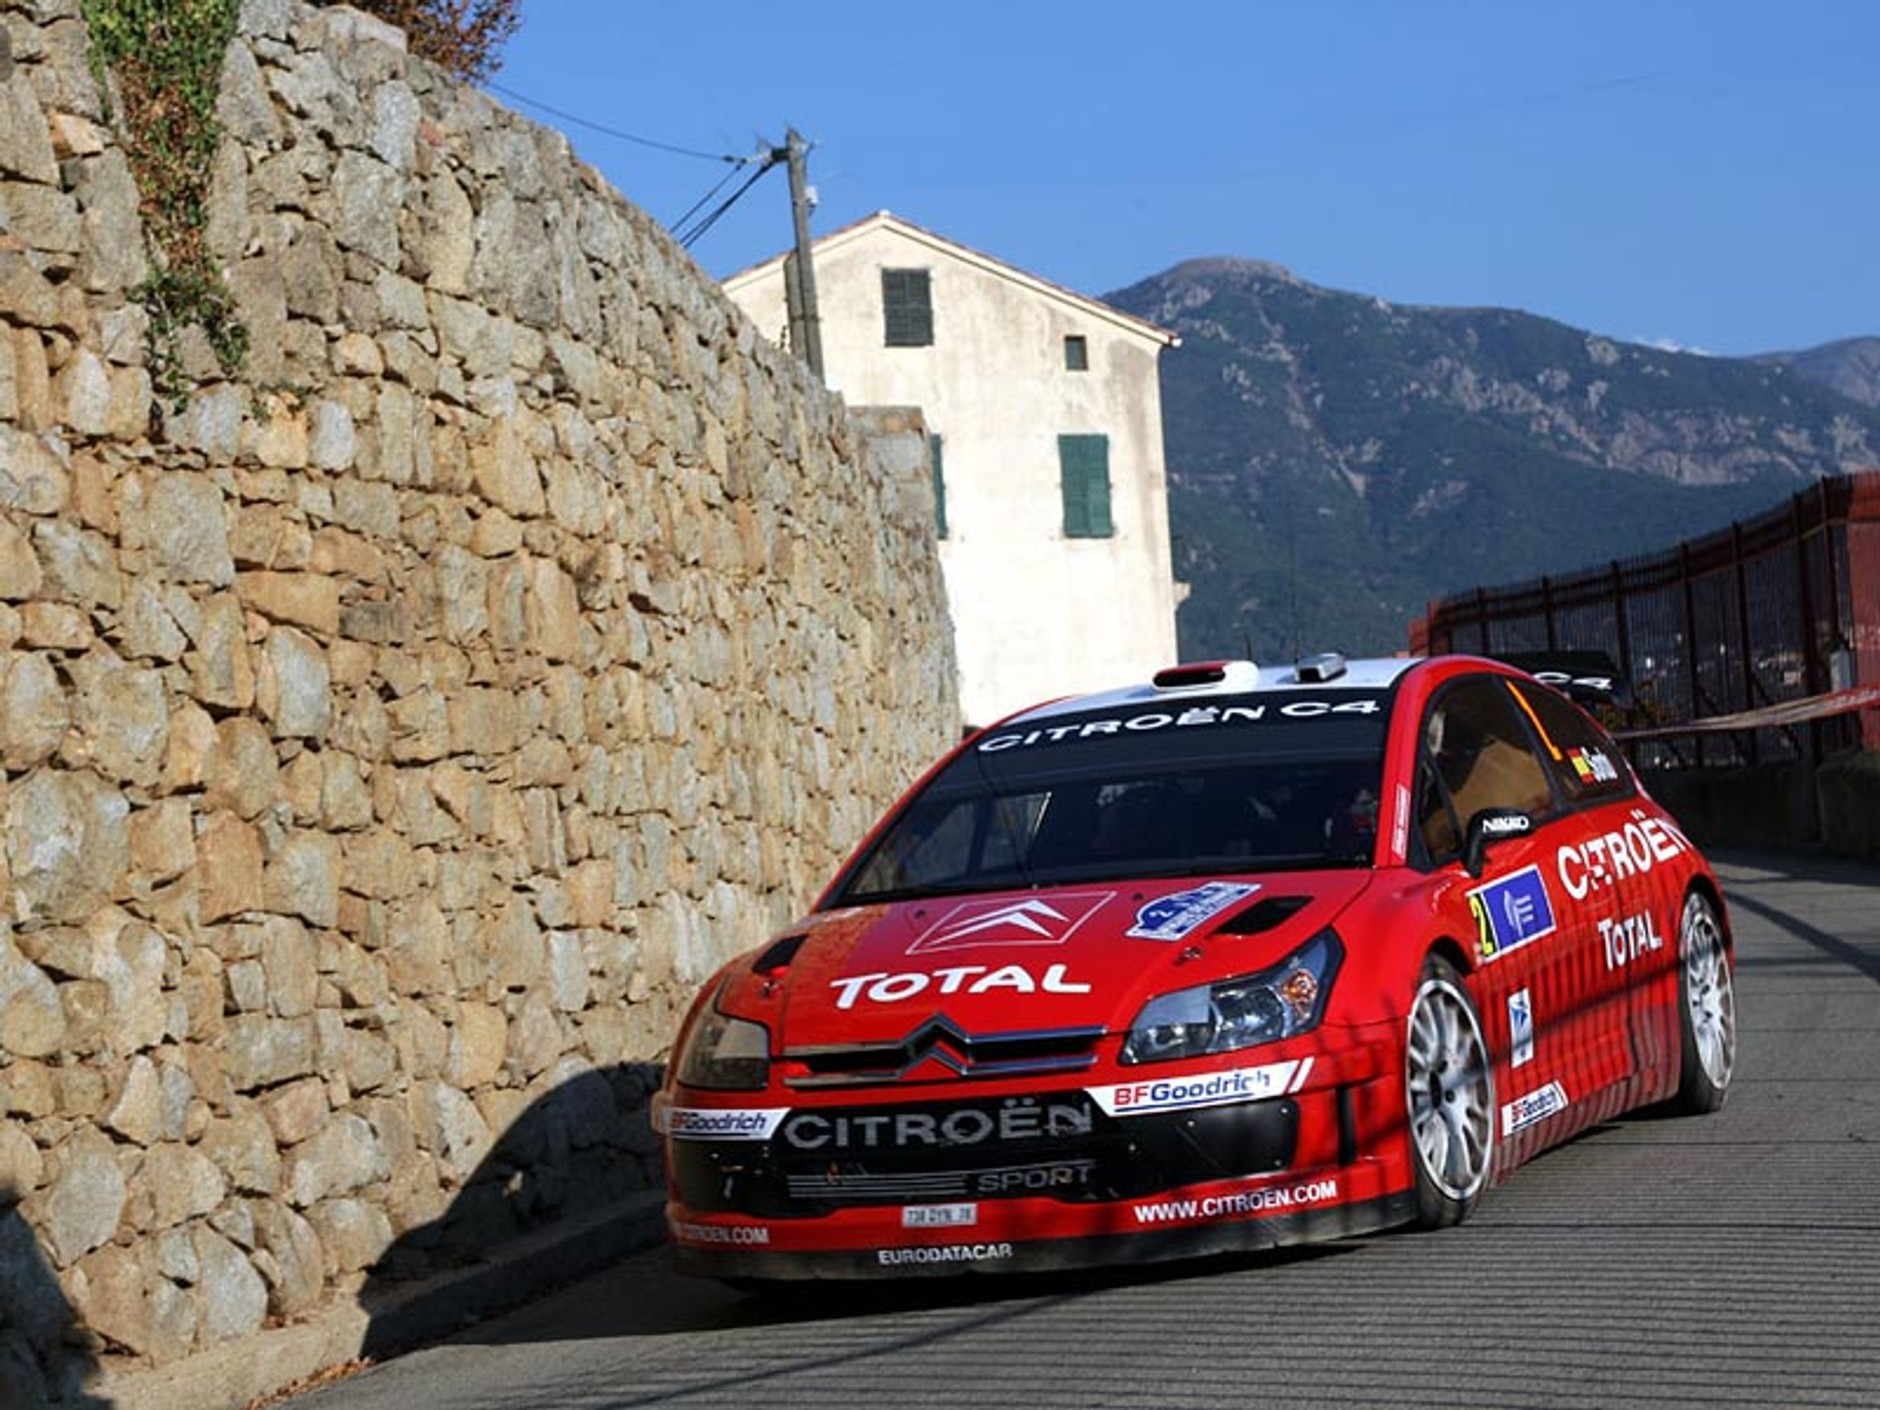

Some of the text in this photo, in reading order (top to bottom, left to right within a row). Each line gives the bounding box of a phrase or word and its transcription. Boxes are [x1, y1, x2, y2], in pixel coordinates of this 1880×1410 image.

[1280, 700, 1380, 716] C4
[1597, 910, 1663, 971] TOTAL
[830, 964, 1092, 1010] TOTAL
[1113, 1070, 1271, 1106] BFGoodrich
[784, 1098, 1093, 1150] CITROËN
[977, 1164, 1096, 1193] SPORT
[1134, 1180, 1337, 1223] WWW.CITROEN.COM
[877, 1243, 1014, 1265] EURODATACAR
